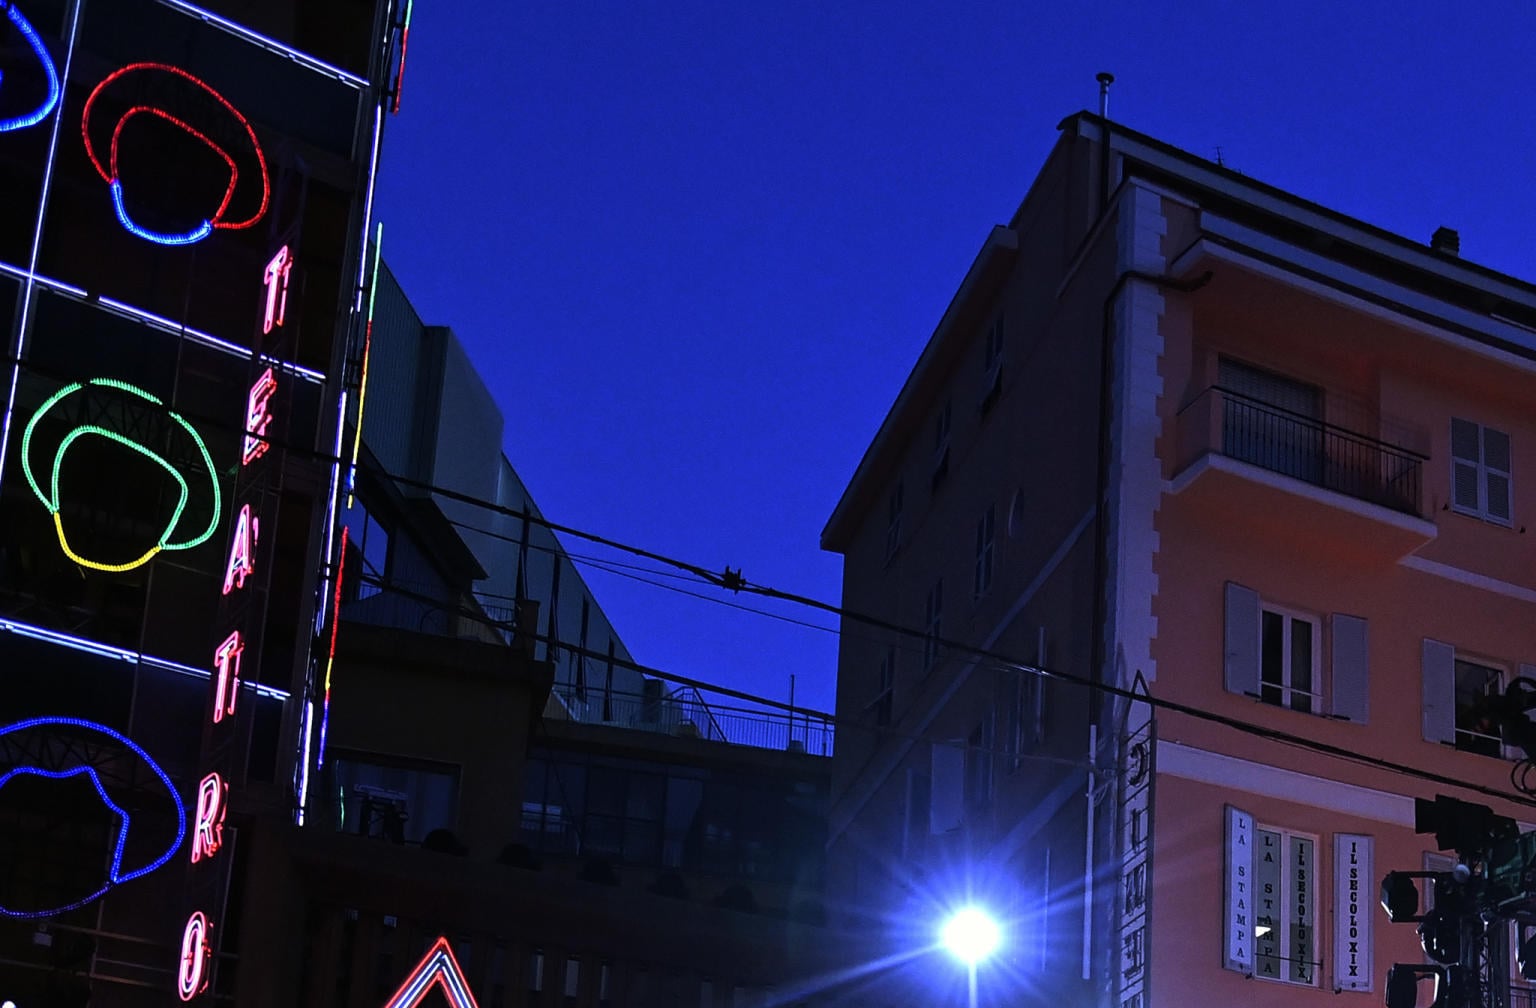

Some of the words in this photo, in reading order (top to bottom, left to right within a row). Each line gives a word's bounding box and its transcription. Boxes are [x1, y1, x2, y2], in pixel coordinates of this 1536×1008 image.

[177, 244, 293, 1003] TEATRO
[1236, 866, 1246, 958] STAMPA
[1349, 868, 1358, 938] SECOLO
